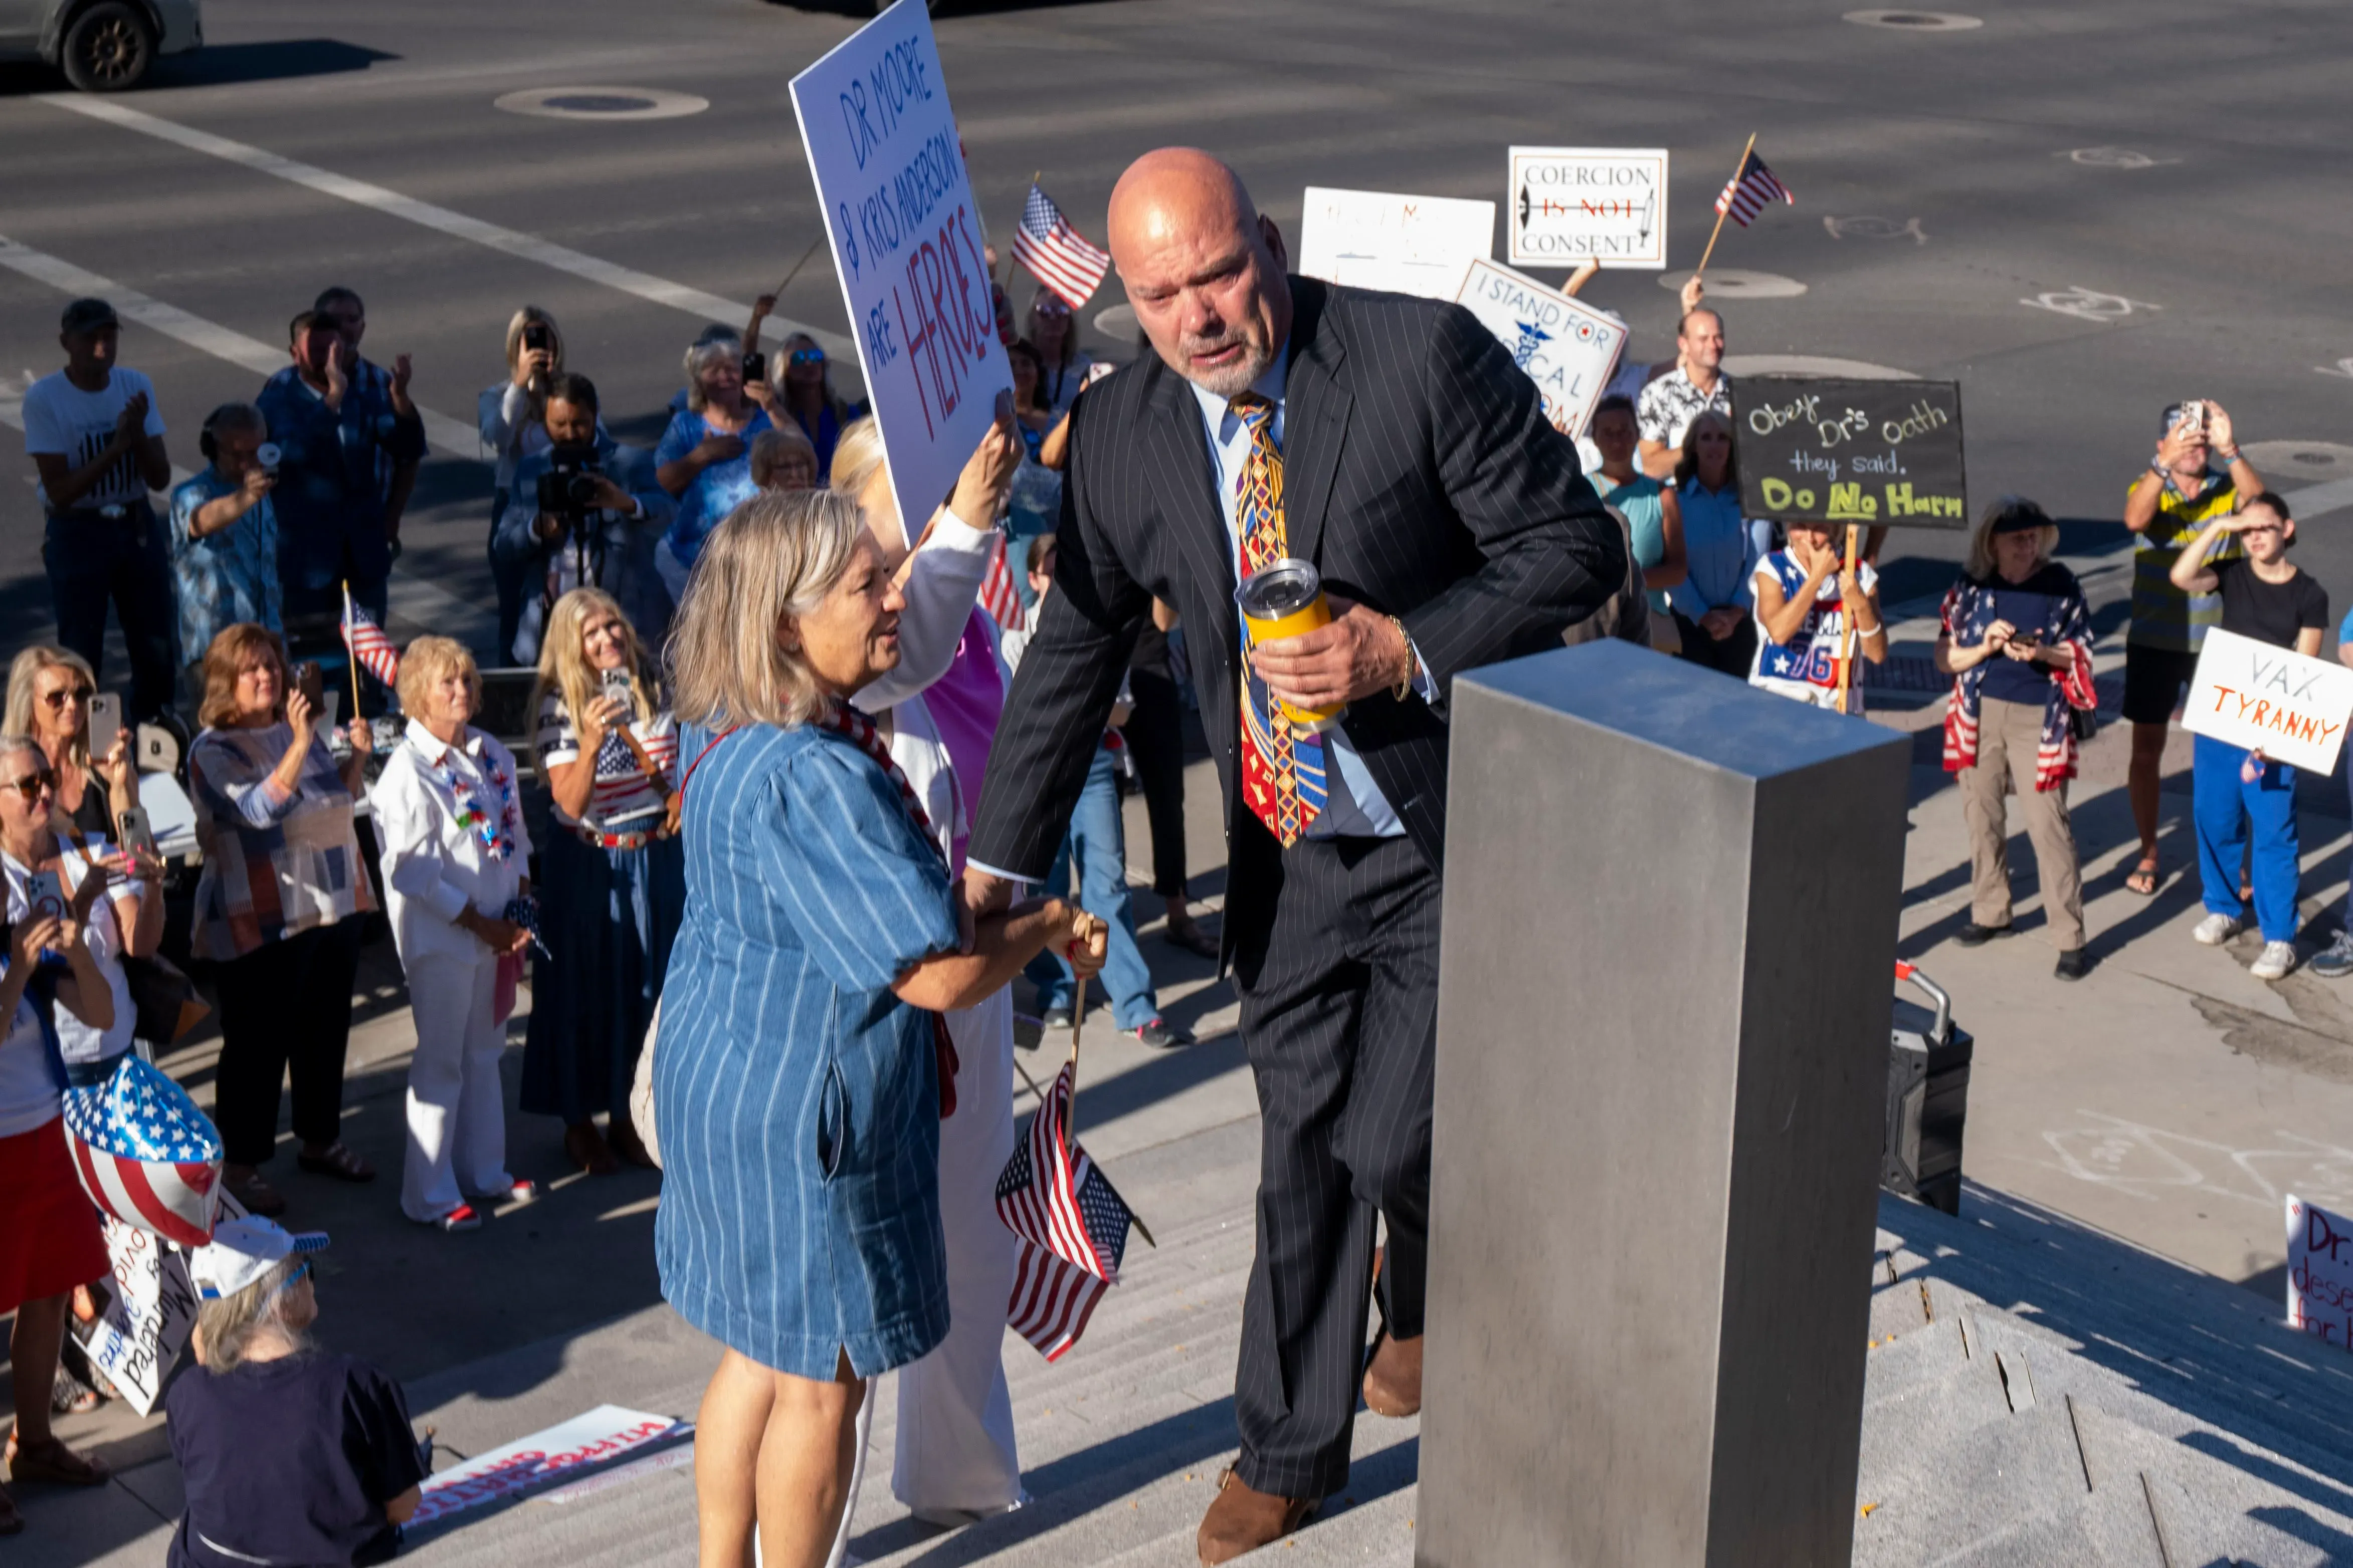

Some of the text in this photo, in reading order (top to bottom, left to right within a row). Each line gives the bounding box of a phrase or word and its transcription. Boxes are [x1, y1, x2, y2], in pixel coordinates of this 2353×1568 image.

[870, 35, 932, 139] MOORE
[857, 183, 899, 272] KRIS
[894, 123, 958, 241] ANDERSON
[1525, 165, 1651, 186] COERCION
[1544, 198, 1637, 218] IS NOT
[1522, 234, 1637, 254] CONSENT
[867, 203, 991, 443] ARE HEROES
[1478, 273, 1610, 352] I STAND FOR
[1749, 393, 1820, 435] Obey
[1789, 449, 1842, 482] they
[1761, 476, 1962, 518] Do No Harm
[2252, 652, 2323, 702] VAX
[2214, 685, 2340, 745] TYRANNY
[114, 1228, 146, 1296] ovid
[123, 1268, 196, 1400] Murdered
